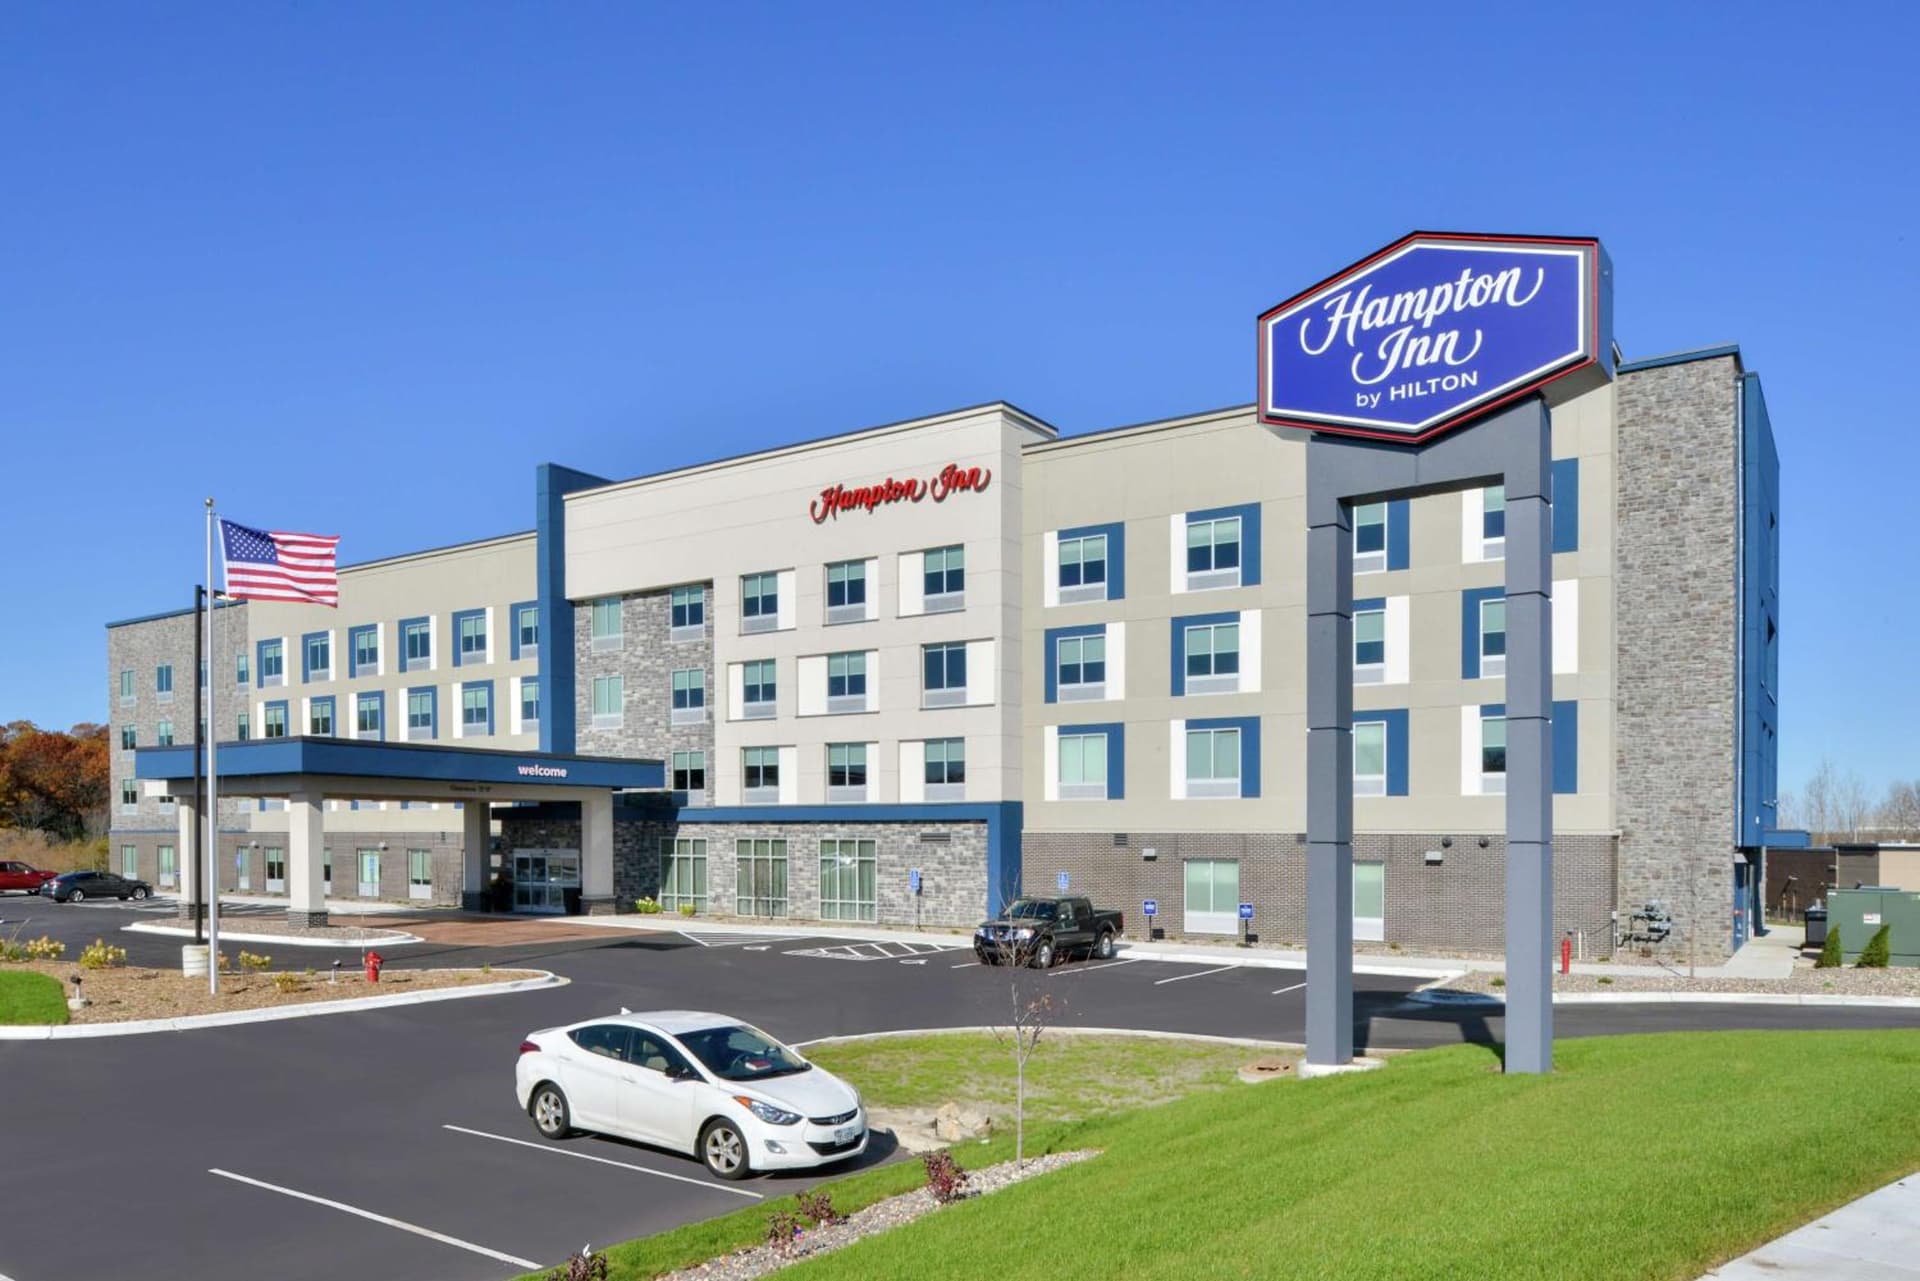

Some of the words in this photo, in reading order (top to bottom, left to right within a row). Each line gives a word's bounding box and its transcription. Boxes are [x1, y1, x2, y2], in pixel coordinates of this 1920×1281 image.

[1300, 267, 1544, 355] Hampton
[1352, 325, 1482, 384] Inn
[1356, 391, 1381, 408] by
[1390, 370, 1478, 401] HILTON
[810, 477, 927, 524] Hampton
[931, 463, 991, 502] Inn
[518, 764, 567, 778] welcome
